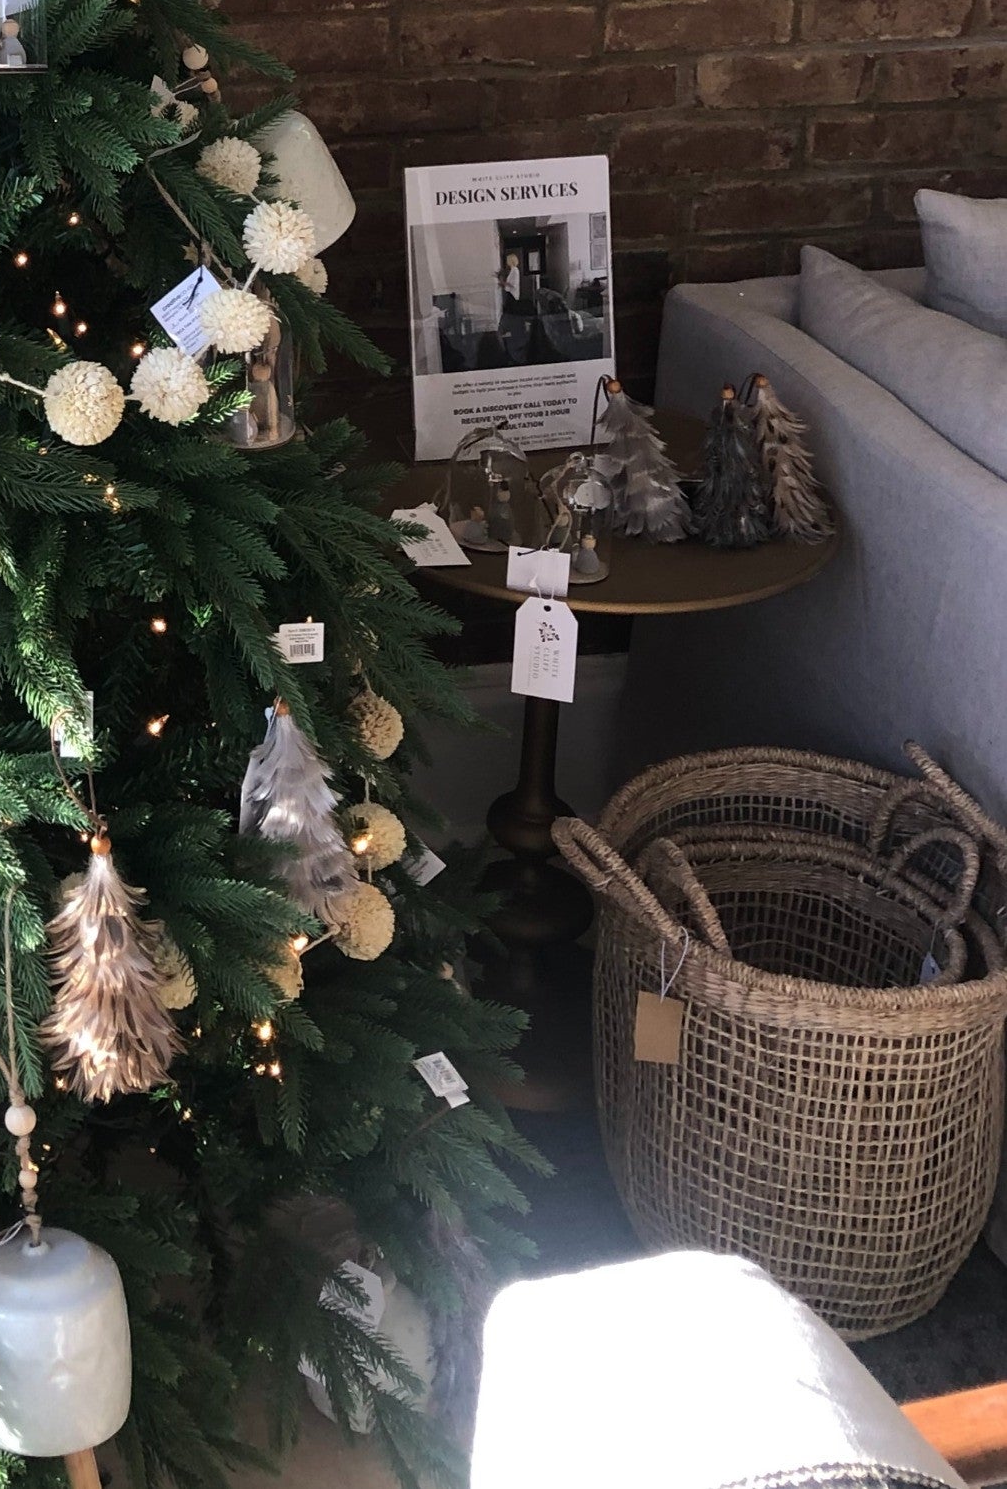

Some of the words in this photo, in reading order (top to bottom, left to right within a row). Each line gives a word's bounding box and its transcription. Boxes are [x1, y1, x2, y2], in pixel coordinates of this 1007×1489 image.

[435, 188, 496, 206] DESIGN
[500, 182, 578, 201] SERVICES
[482, 403, 522, 413] DISCOVERY
[542, 399, 567, 407] TODAY
[461, 416, 491, 424] RECEIVE
[523, 411, 544, 419] YOUR
[550, 408, 570, 416] HOUR
